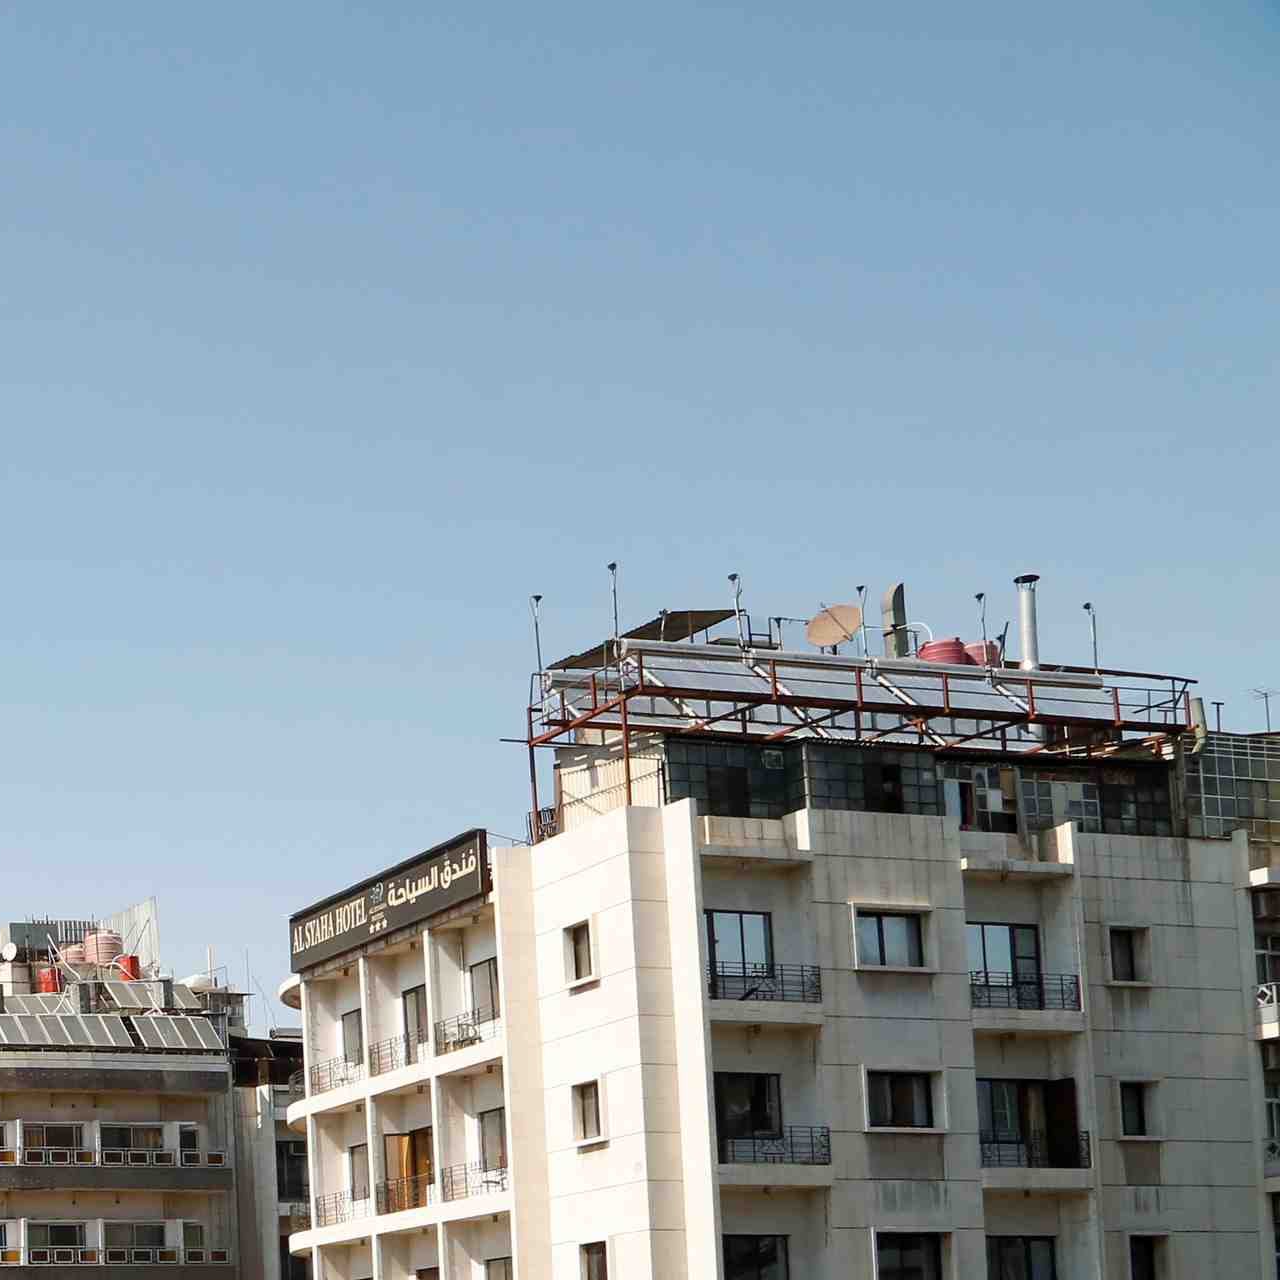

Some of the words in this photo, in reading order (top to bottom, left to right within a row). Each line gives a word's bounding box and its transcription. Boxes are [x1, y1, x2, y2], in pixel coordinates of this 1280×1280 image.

[387, 866, 439, 907] السياحة
[440, 849, 477, 889] فندق
[292, 929, 305, 954] AL
[305, 912, 334, 949] SYAHA
[336, 896, 368, 936] HOTEL
